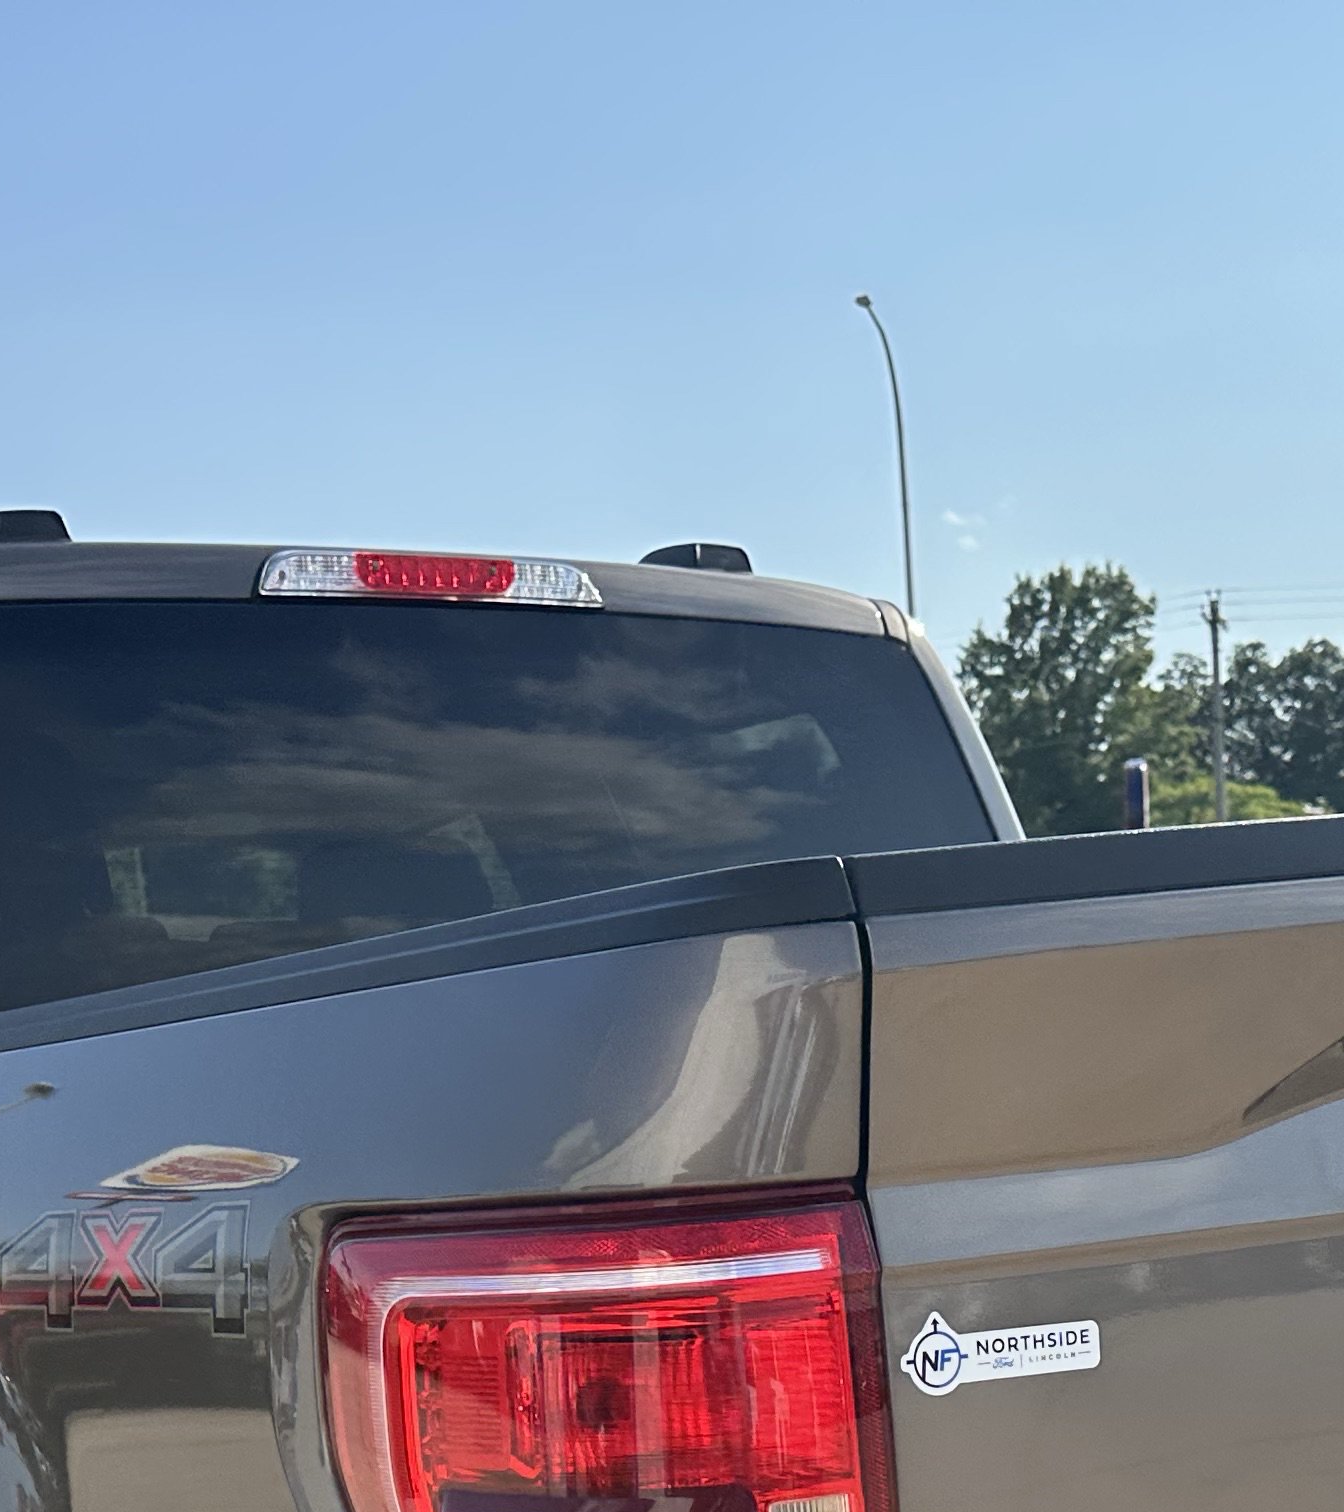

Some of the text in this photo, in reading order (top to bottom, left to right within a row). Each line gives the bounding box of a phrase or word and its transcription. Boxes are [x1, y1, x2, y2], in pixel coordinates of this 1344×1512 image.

[976, 1329, 1090, 1355] NORTHSIDE
[922, 1348, 960, 1382] NF
[1028, 1351, 1077, 1363] LINCOLN
